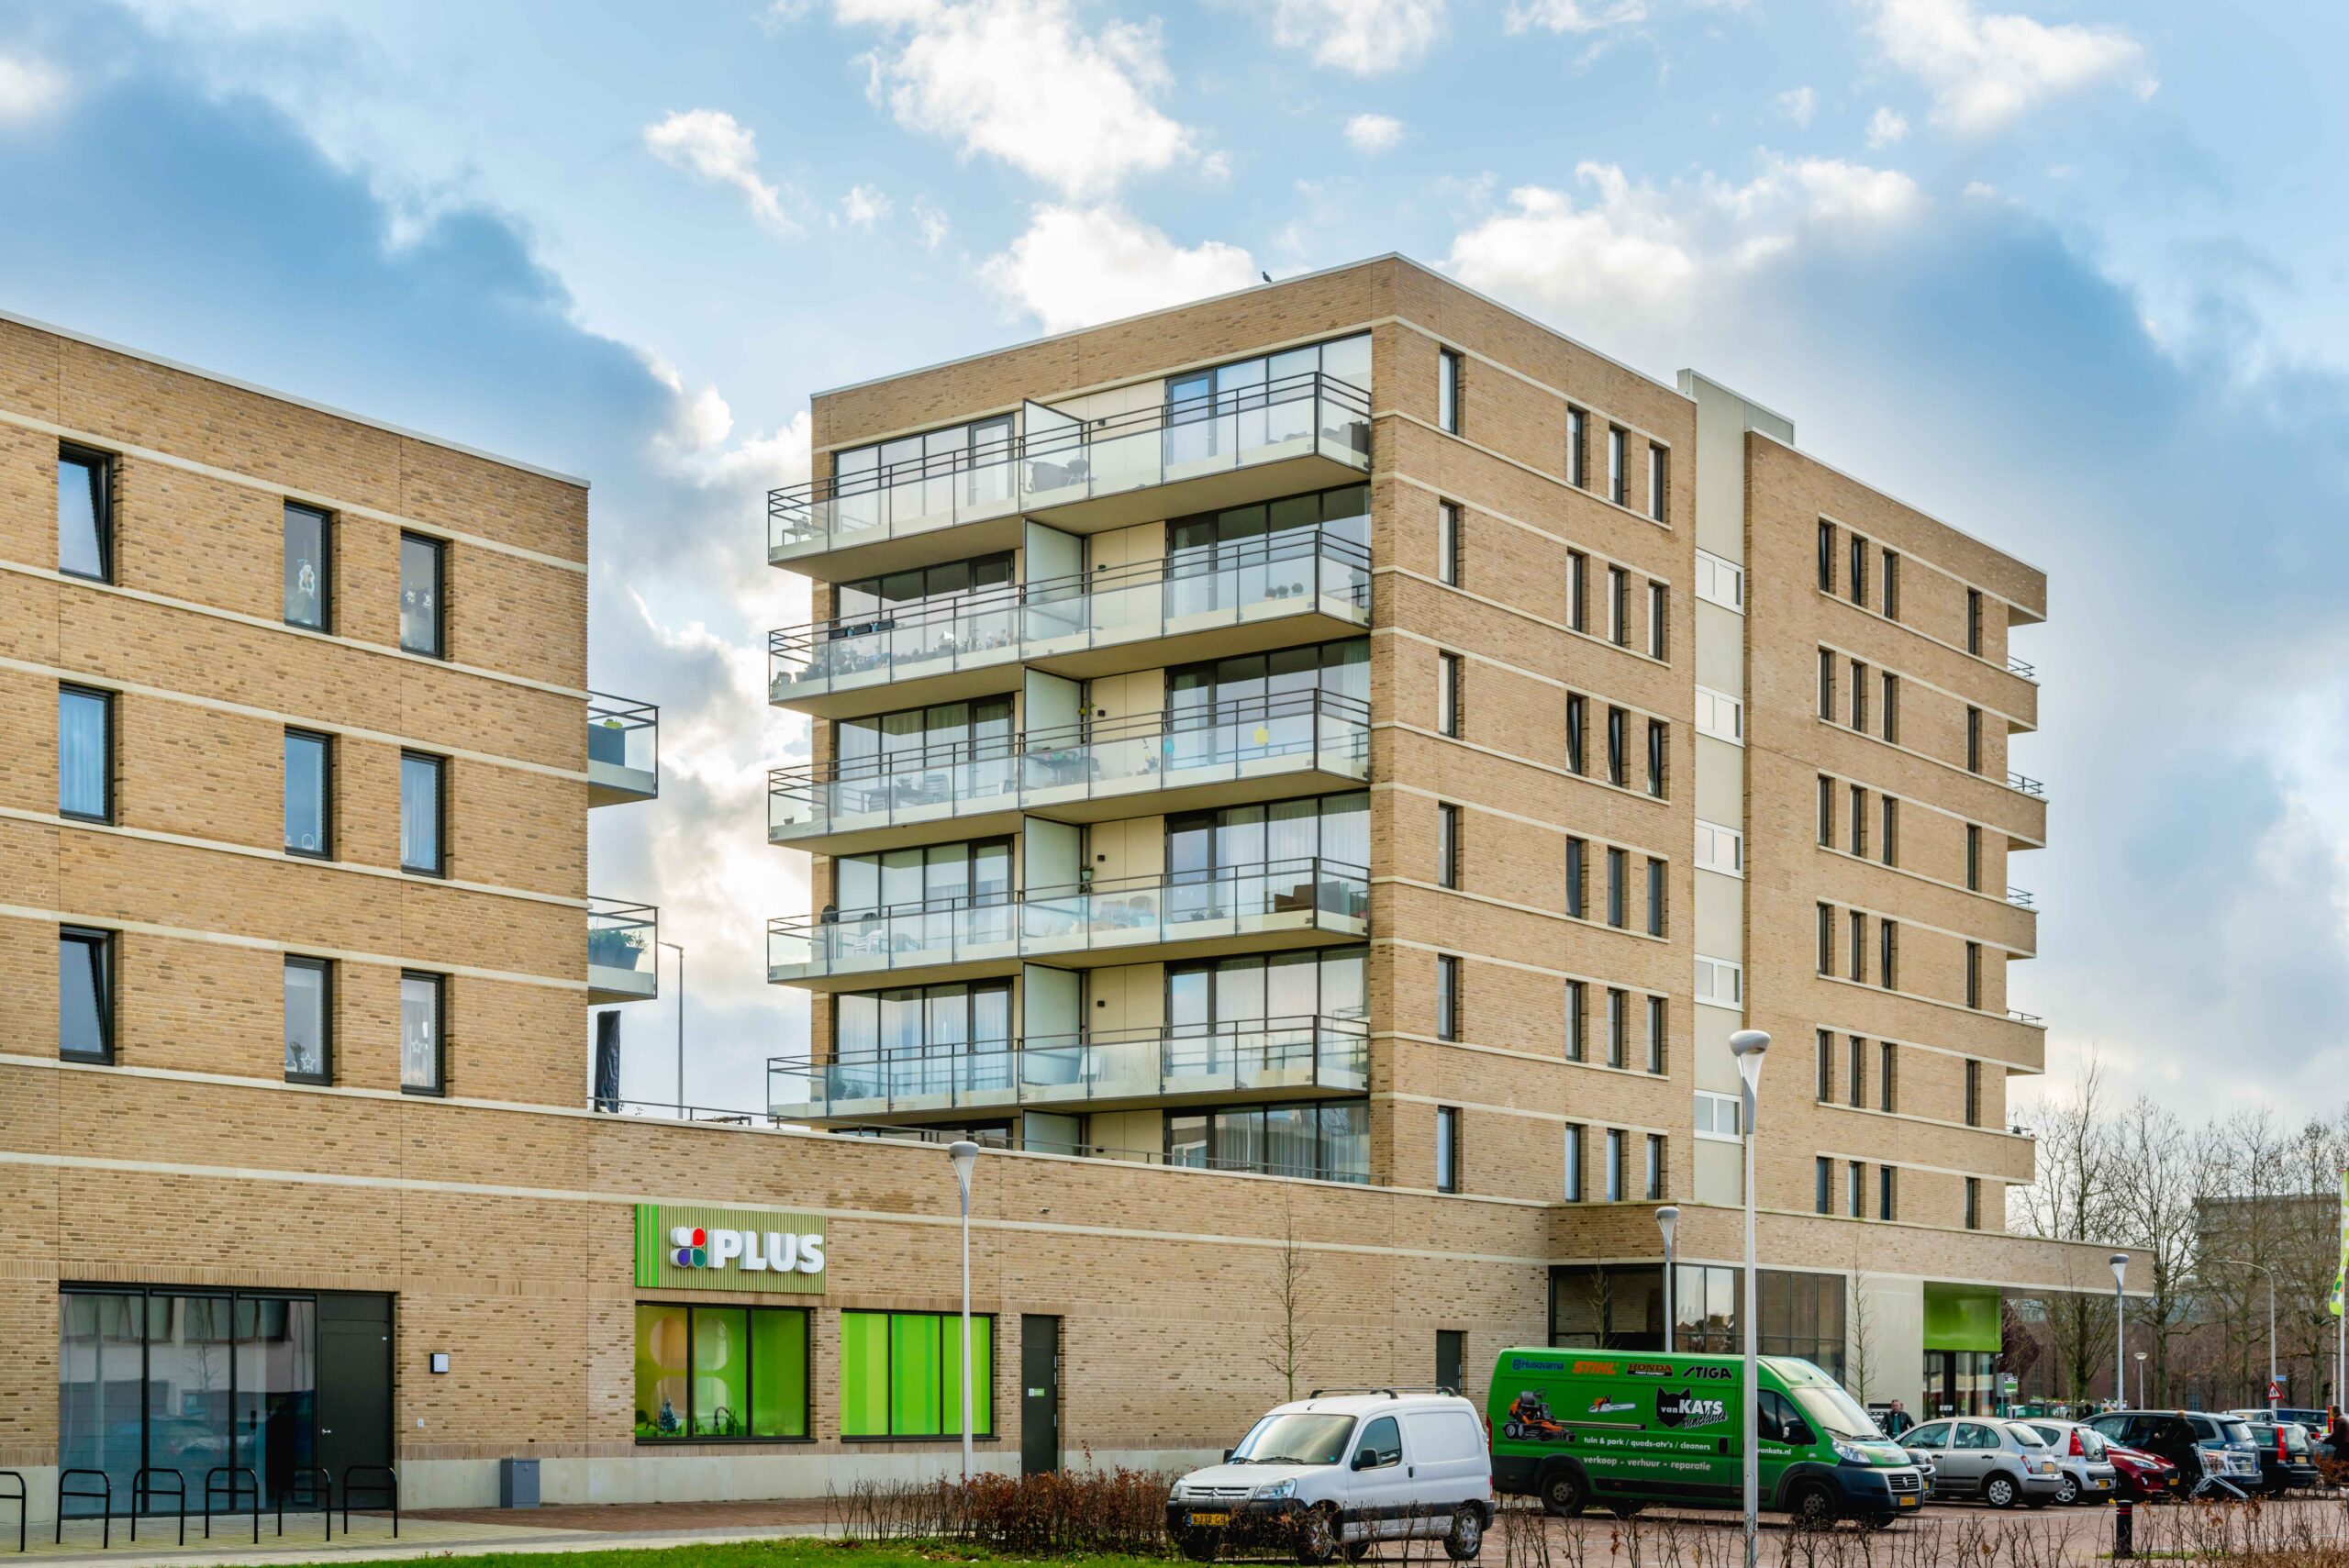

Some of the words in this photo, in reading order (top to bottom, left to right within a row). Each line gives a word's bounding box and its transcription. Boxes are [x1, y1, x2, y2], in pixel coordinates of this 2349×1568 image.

[707, 1229, 825, 1273] PLUS
[1522, 1359, 1564, 1371] Husqvarna
[1572, 1361, 1616, 1375] STIHL
[1627, 1363, 1673, 1373] HONDA
[1683, 1366, 1732, 1379] STIGA
[1678, 1399, 1723, 1415] KATS
[1631, 1440, 1673, 1448] quads-atv's
[1680, 1442, 1711, 1451] cleaners
[1584, 1456, 1618, 1466] verkoop
[1627, 1458, 1661, 1467] verhuur
[1671, 1462, 1711, 1471] reparatie
